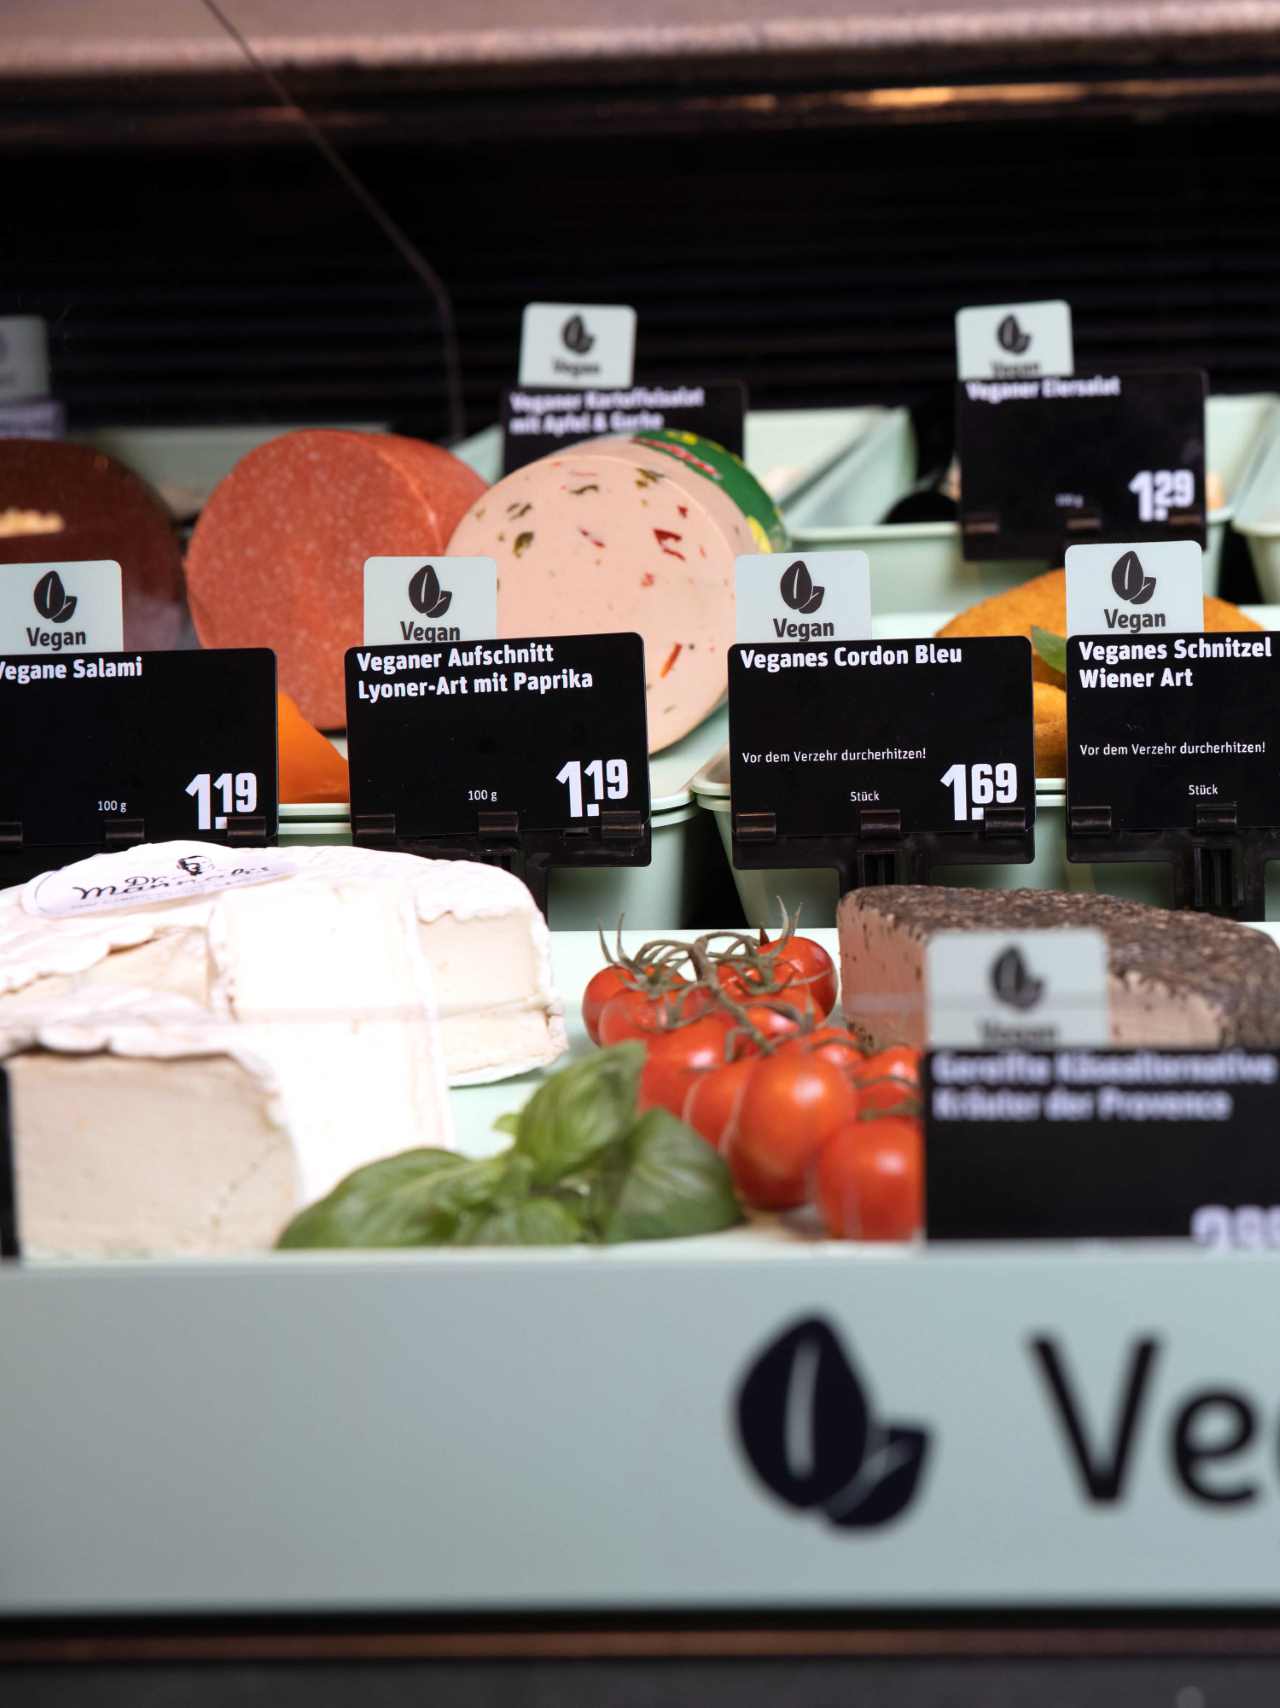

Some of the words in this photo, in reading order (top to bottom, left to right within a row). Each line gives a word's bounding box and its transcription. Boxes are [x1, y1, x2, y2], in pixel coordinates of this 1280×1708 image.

[773, 617, 835, 642] Vegan
[1104, 608, 1166, 633] Vegan
[26, 627, 86, 651] Vegan
[400, 621, 461, 643] Vegan
[357, 652, 442, 675] Veganer
[448, 643, 554, 668] Aufschnitt
[740, 649, 829, 673] Veganes
[834, 645, 909, 667] Cordon
[915, 643, 962, 664] Bleu
[1078, 641, 1168, 664] Veganes
[1174, 636, 1272, 659] Schnitzel
[73, 656, 143, 679] Salami
[1079, 668, 1154, 689] Wiener
[1160, 667, 1193, 687] Art
[358, 674, 468, 703] Lyoner-Art
[474, 672, 508, 693] mit
[514, 669, 593, 694] Paprika
[742, 752, 762, 764] Vor
[765, 750, 790, 763] dem
[793, 750, 838, 762] Verzehr
[841, 747, 927, 761] durcherhitzen!
[1080, 744, 1100, 756] Vor
[1103, 743, 1128, 756] dem
[1131, 743, 1176, 755] Verzehr
[1179, 740, 1266, 754] durcherhitzen!
[467, 789, 488, 801] 100
[490, 791, 498, 802] g
[850, 790, 880, 802] Stück
[1188, 784, 1218, 796] Stück
[97, 800, 118, 812] 100
